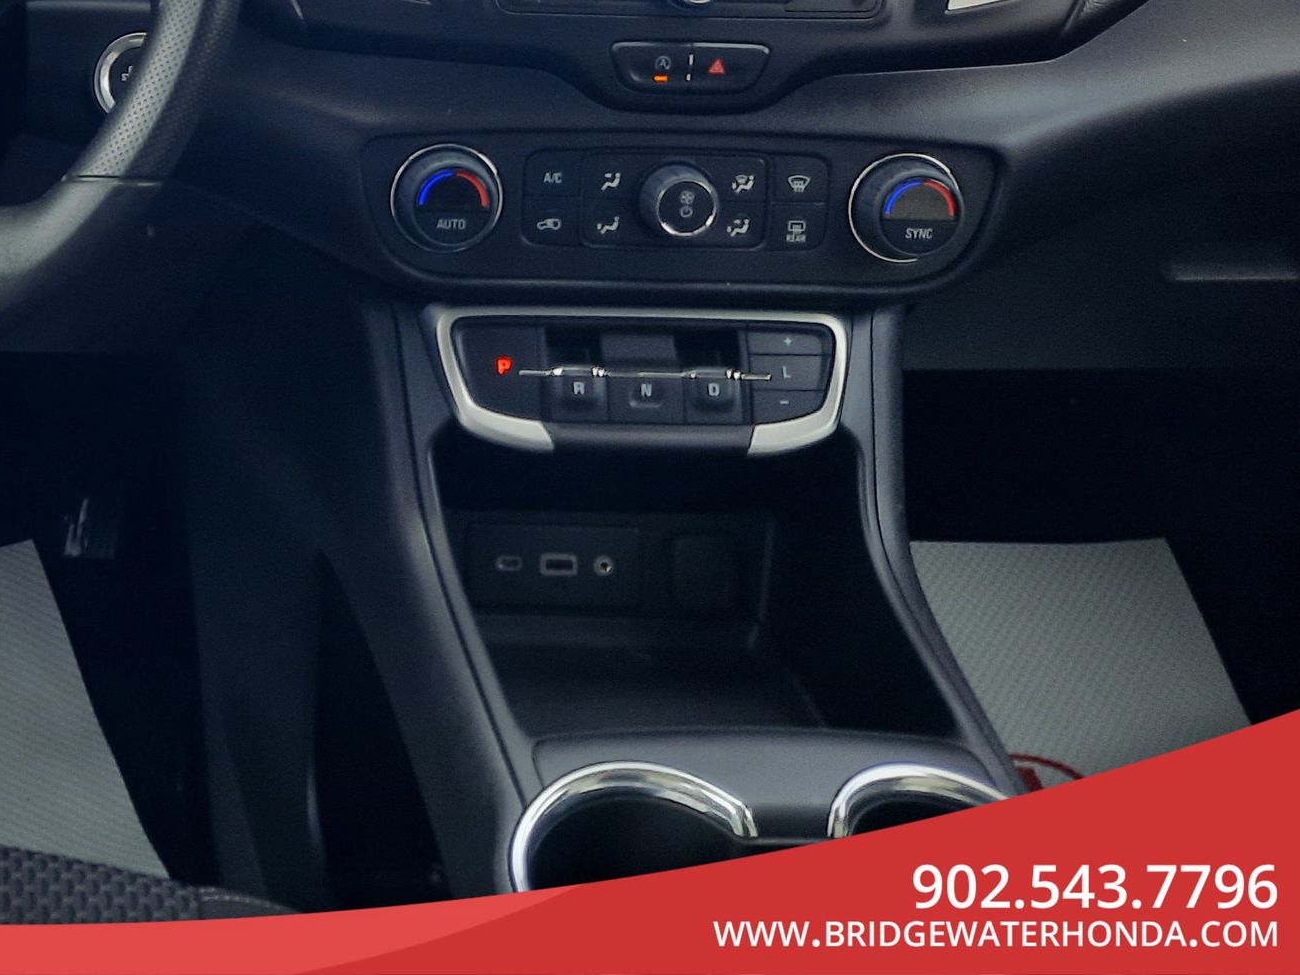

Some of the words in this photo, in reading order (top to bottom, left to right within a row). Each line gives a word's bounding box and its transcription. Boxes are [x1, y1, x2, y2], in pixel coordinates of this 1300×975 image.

[543, 172, 563, 184] A/C
[436, 219, 466, 230] AUTO
[786, 234, 806, 243] REAR
[905, 228, 933, 239] SYNC
[496, 358, 512, 374] P
[782, 366, 791, 379] L
[572, 381, 585, 395] R
[640, 383, 652, 397] N
[708, 382, 720, 396] D
